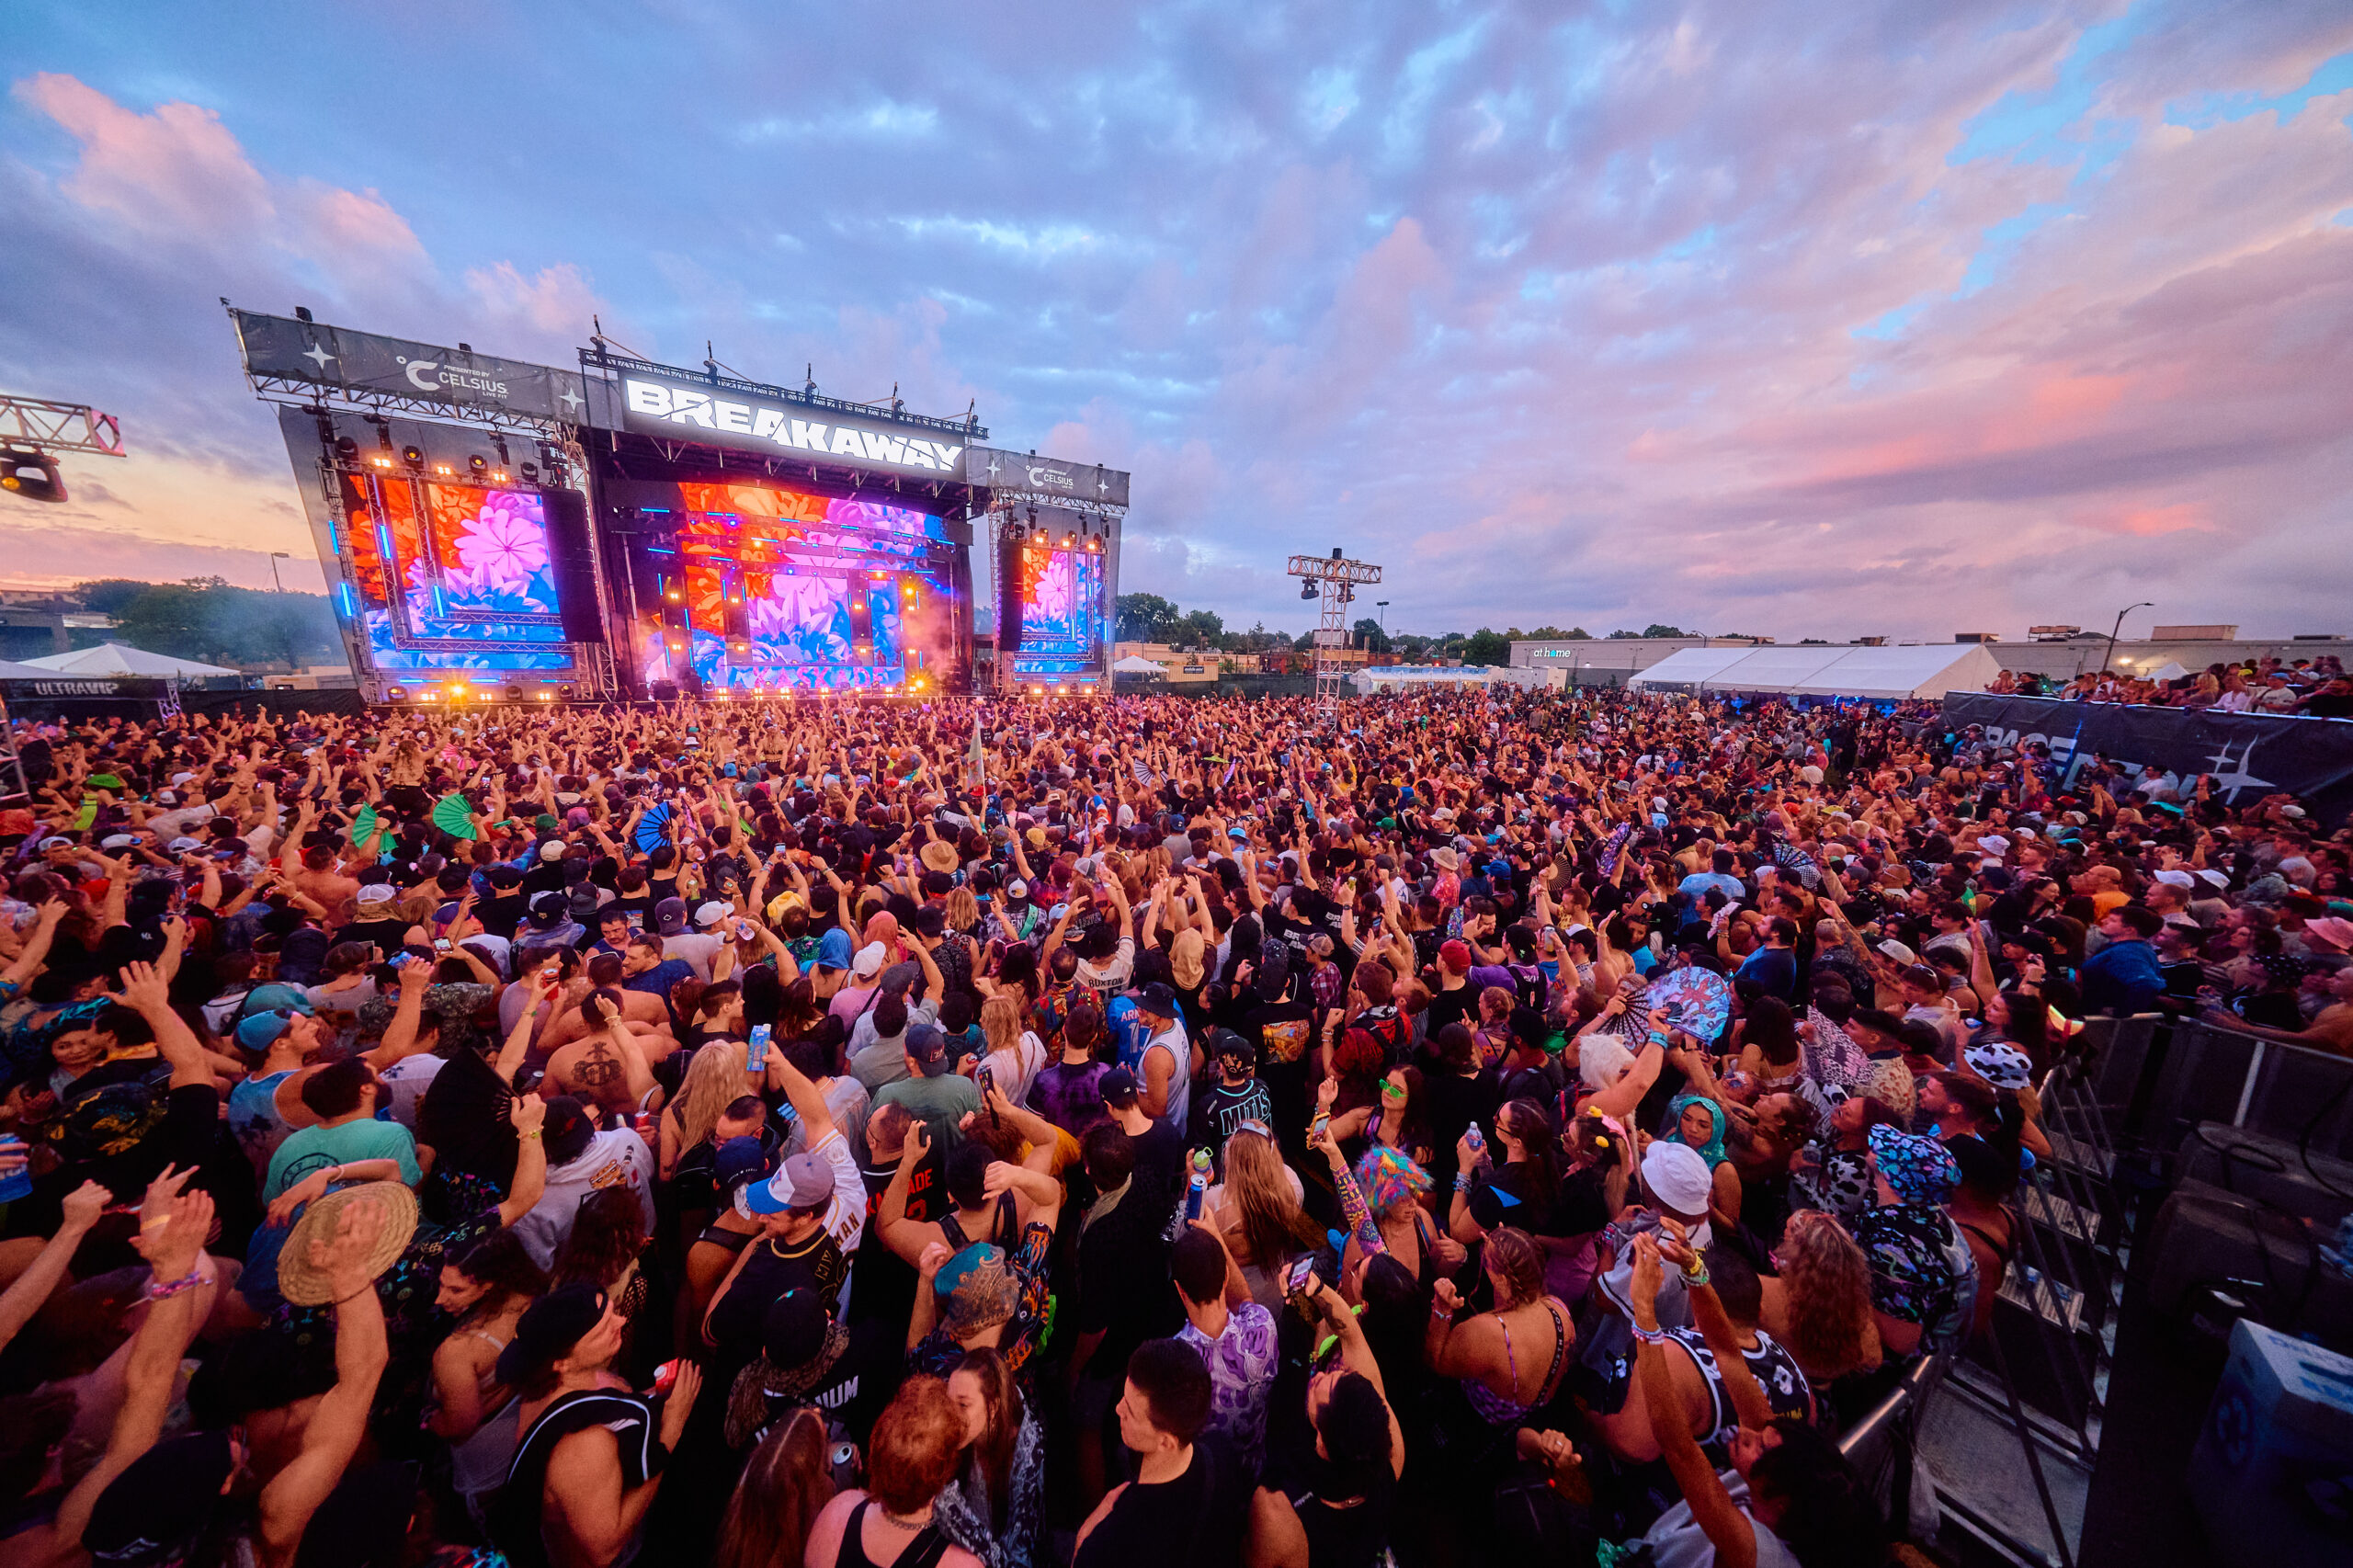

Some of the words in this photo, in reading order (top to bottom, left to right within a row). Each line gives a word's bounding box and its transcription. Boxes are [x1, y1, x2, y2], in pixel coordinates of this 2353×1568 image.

[444, 364, 481, 376] PRESENTED
[438, 371, 507, 394] CELSIUS
[625, 379, 963, 472] BREAKAWAY
[1043, 473, 1074, 486] CELSIUS
[1533, 648, 1543, 657] at
[1088, 977, 1124, 988] BUXTON
